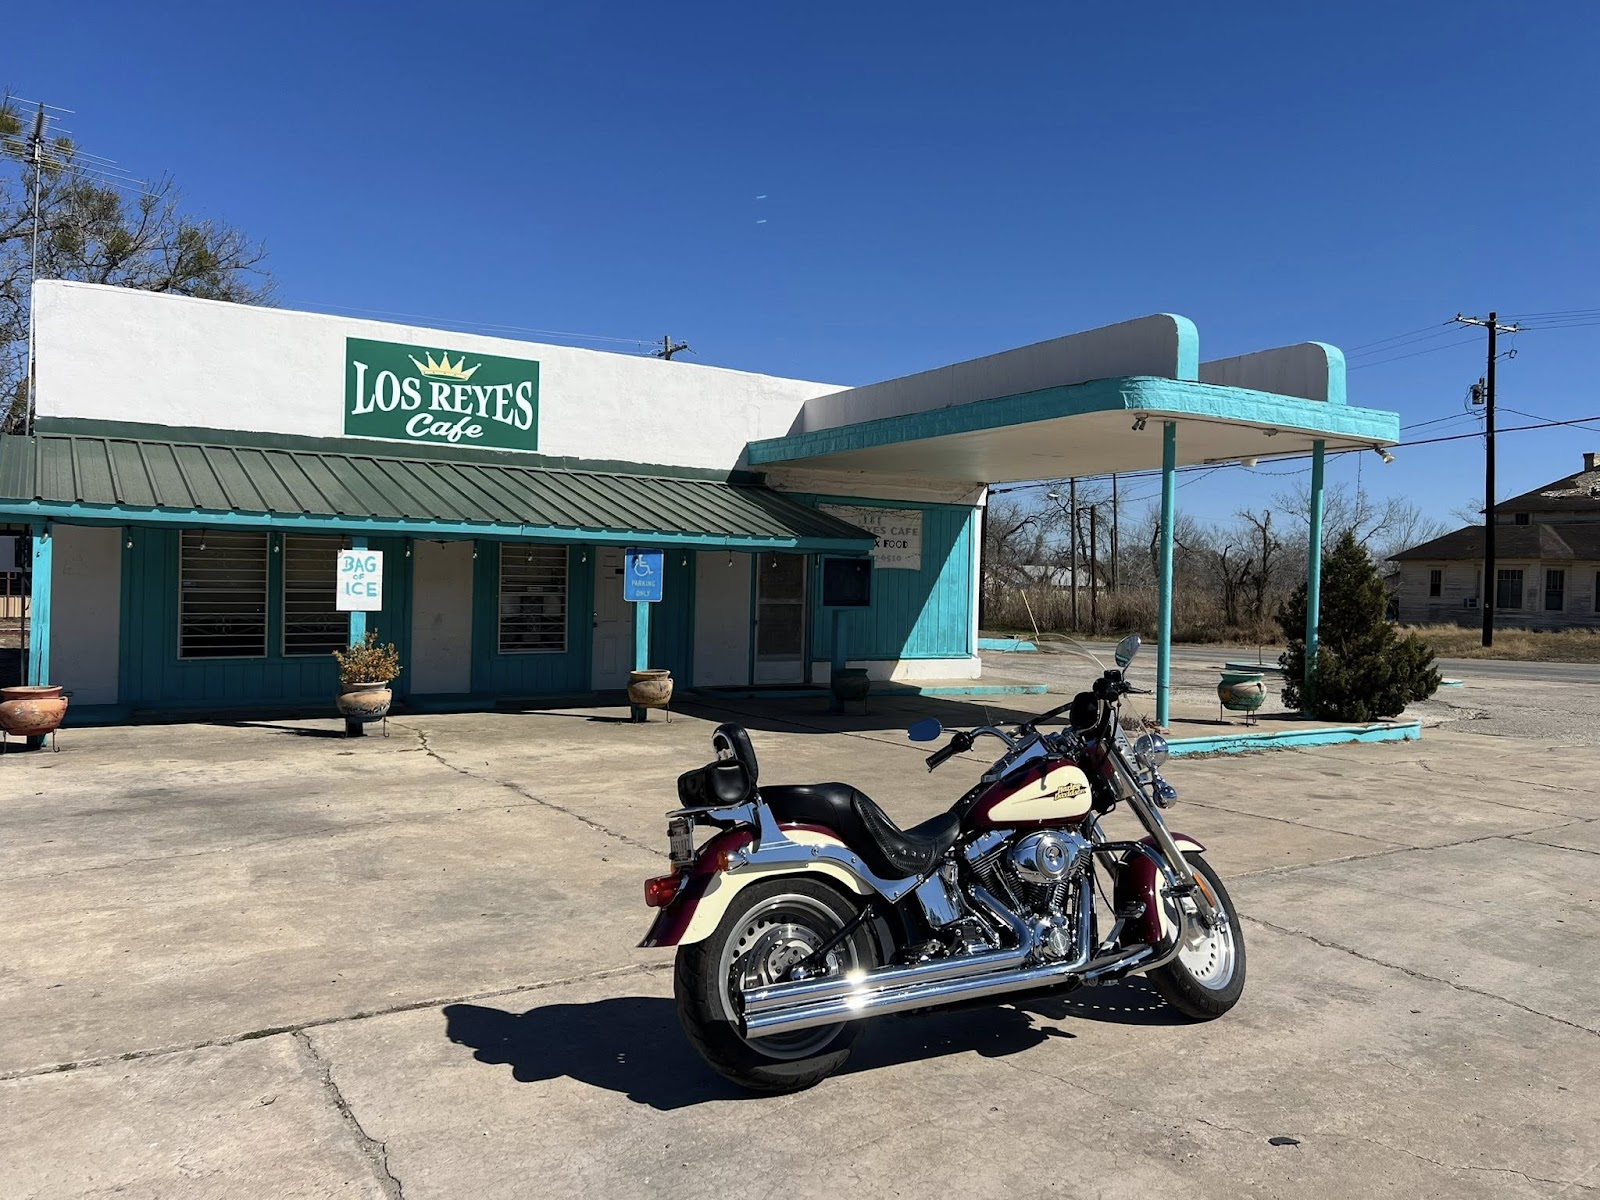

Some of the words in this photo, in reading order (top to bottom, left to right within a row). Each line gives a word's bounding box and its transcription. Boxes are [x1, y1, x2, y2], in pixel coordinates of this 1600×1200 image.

[351, 361, 422, 415] LOS
[428, 381, 533, 431] REYES
[405, 413, 484, 443] Cafe
[891, 527, 919, 536] CAFE
[884, 540, 908, 548] FOOD
[342, 555, 377, 573] BAG
[345, 581, 378, 597] ICE
